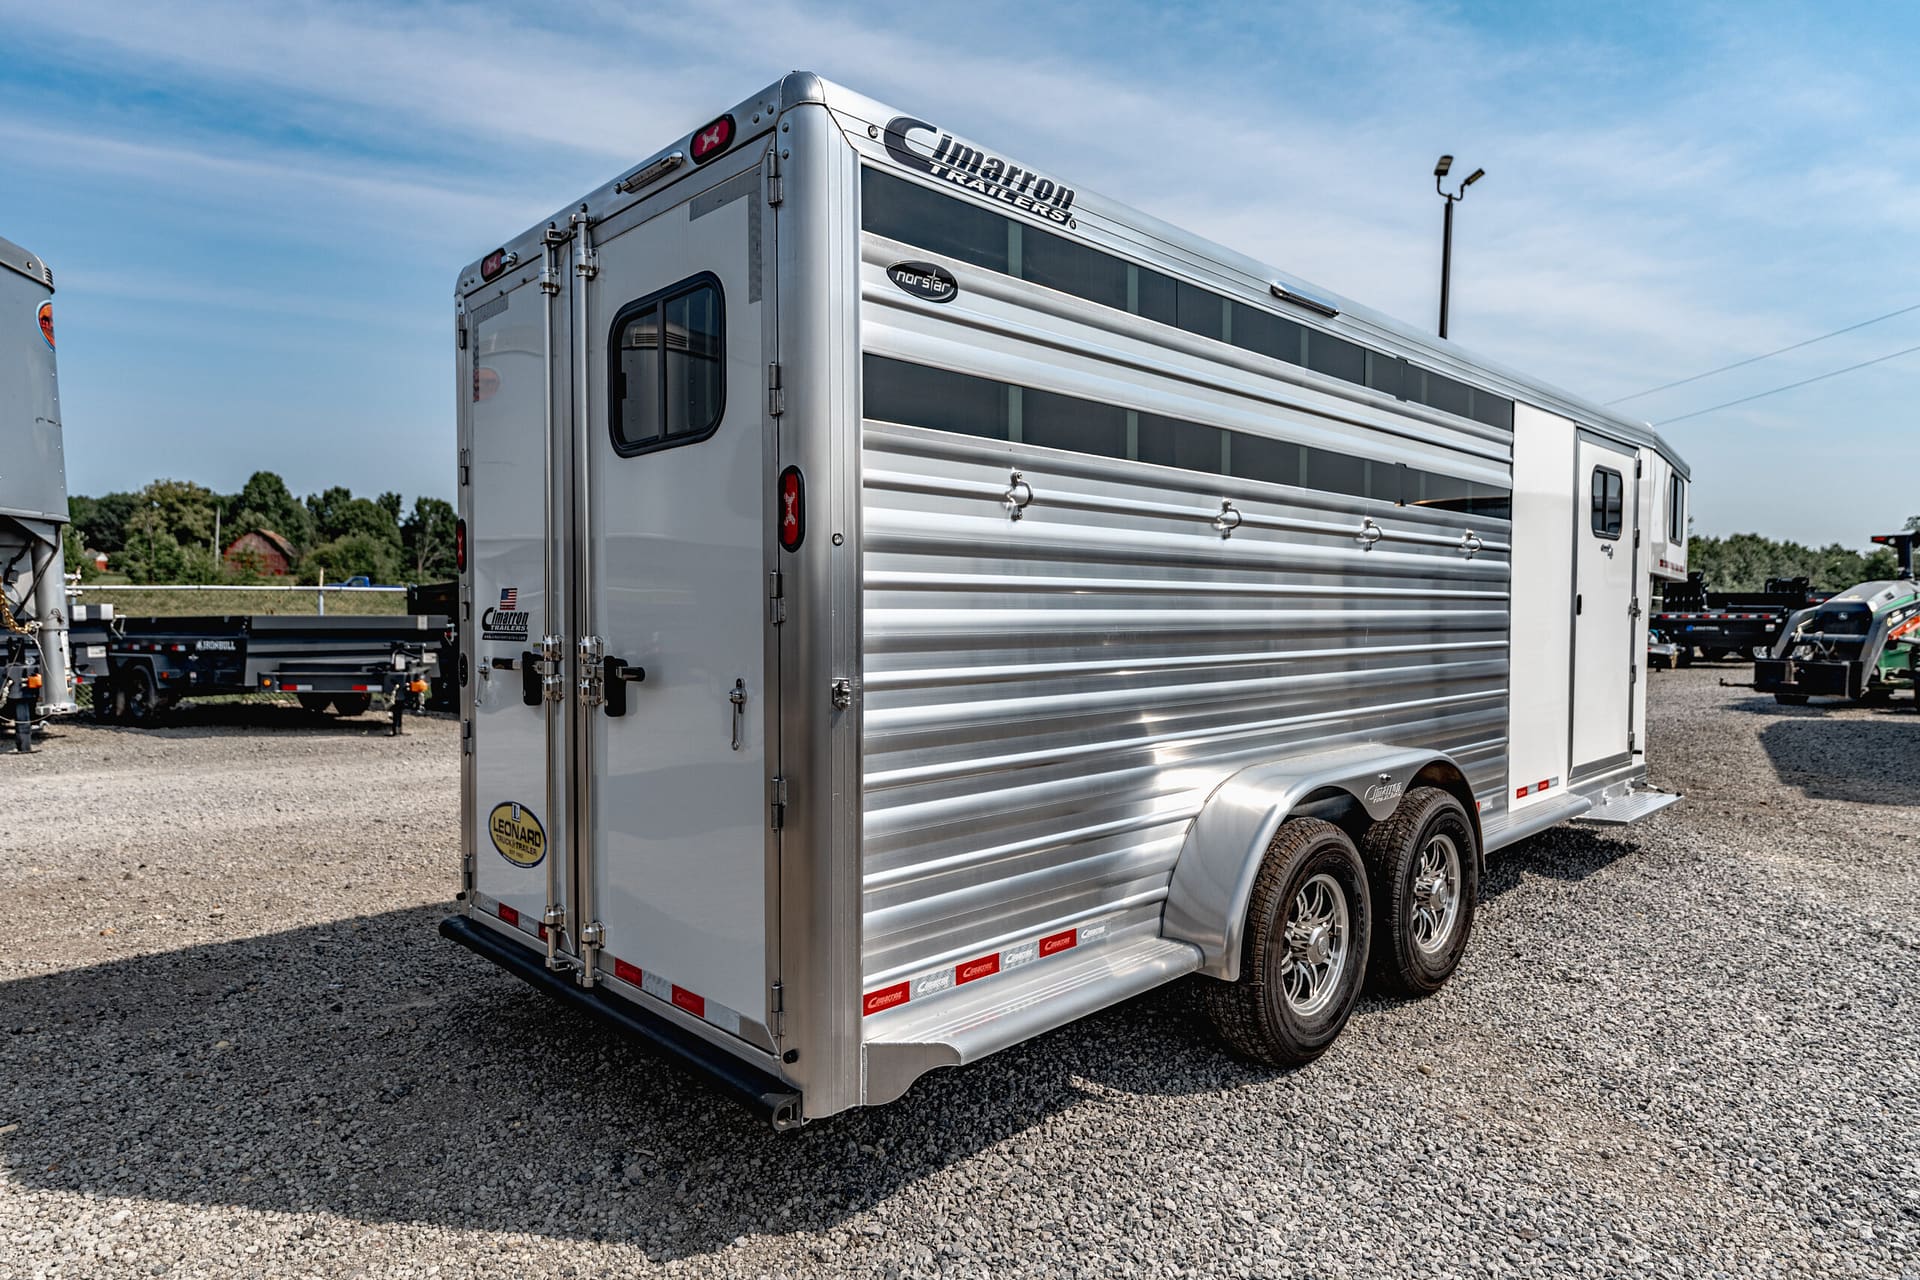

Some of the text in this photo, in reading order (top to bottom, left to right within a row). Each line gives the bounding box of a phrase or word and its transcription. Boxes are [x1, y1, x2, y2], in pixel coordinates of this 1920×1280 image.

[884, 116, 1075, 211] Cimarron
[929, 161, 1068, 224] TRAILERS
[896, 269, 951, 293] norstar
[482, 607, 529, 627] Cimarron
[490, 624, 526, 632] TRAILERS
[203, 640, 236, 650] IRONBULL
[493, 816, 541, 848] LEONARD
